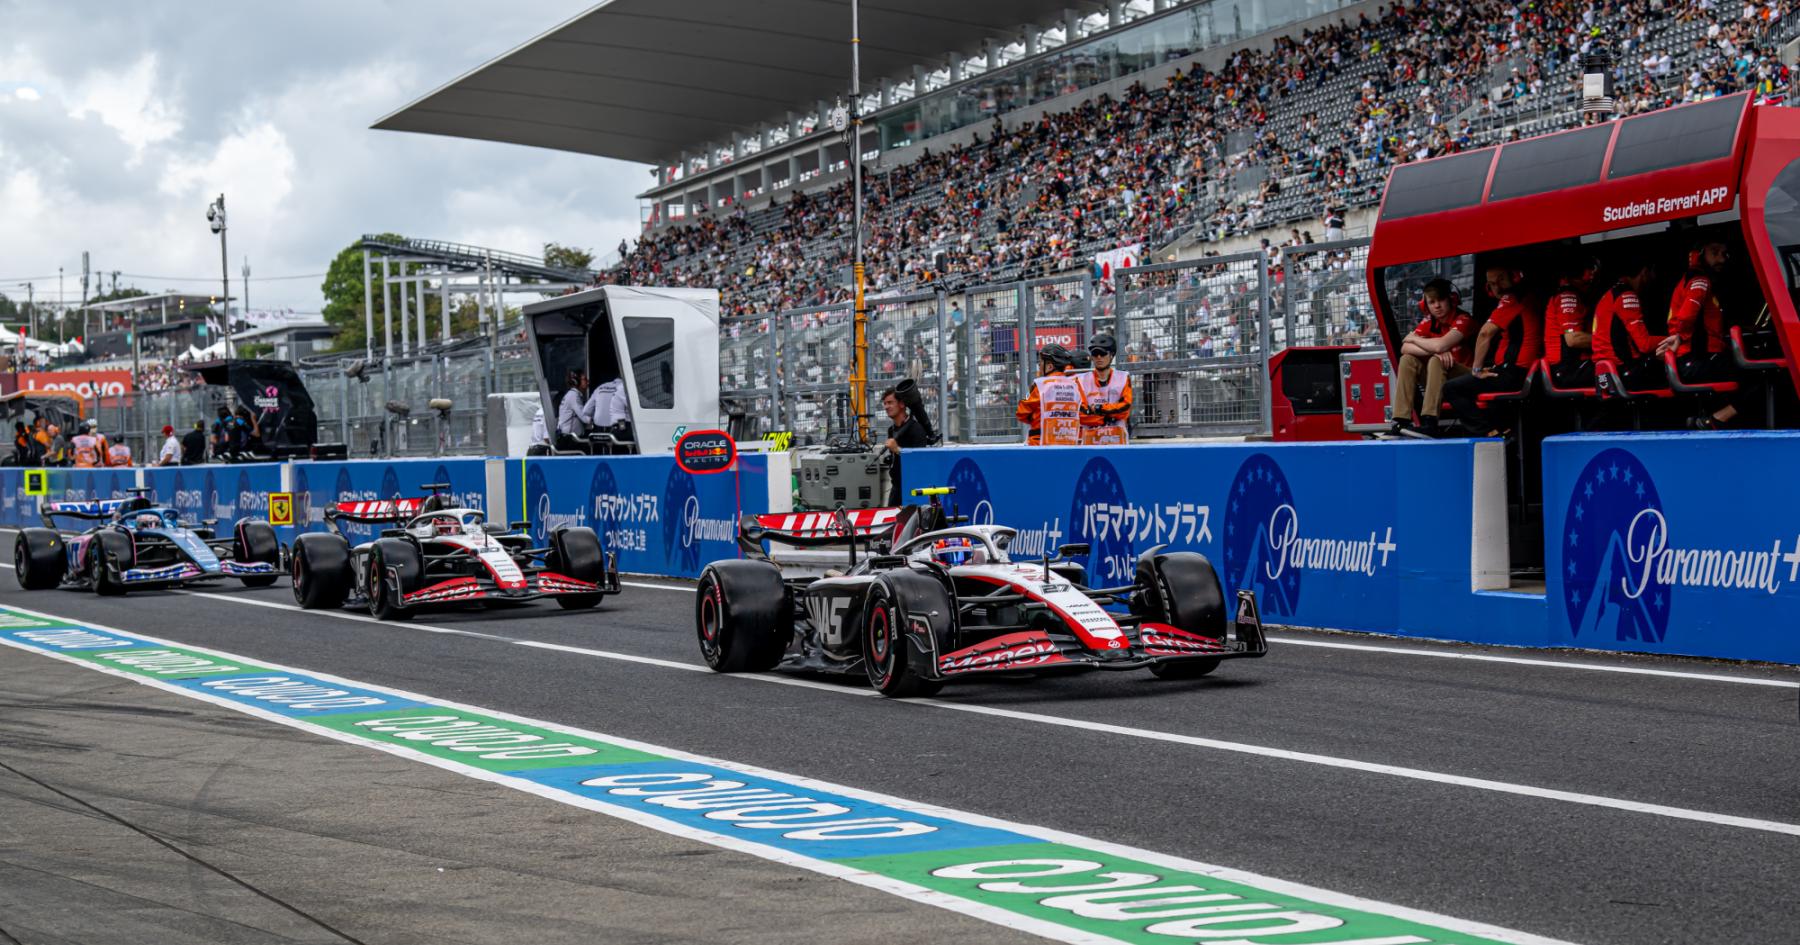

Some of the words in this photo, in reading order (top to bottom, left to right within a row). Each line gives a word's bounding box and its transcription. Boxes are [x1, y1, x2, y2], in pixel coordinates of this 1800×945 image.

[1603, 200, 1656, 222] Scuderia
[1657, 190, 1700, 213] Ferrari
[1700, 186, 1728, 206] APP
[1035, 335, 1072, 345] novo
[684, 440, 727, 449] ORACLE
[685, 456, 728, 465] RACING
[594, 494, 659, 523] パラマウントプラス
[1082, 501, 1213, 545] パラマウントプラス
[1265, 504, 1397, 580] Paramount+
[1621, 508, 1800, 599] Paramount+
[1104, 553, 1137, 582] ついに
[1040, 583, 1071, 594] 27
[578, 773, 940, 841] aramco
[928, 858, 1434, 945] amco
